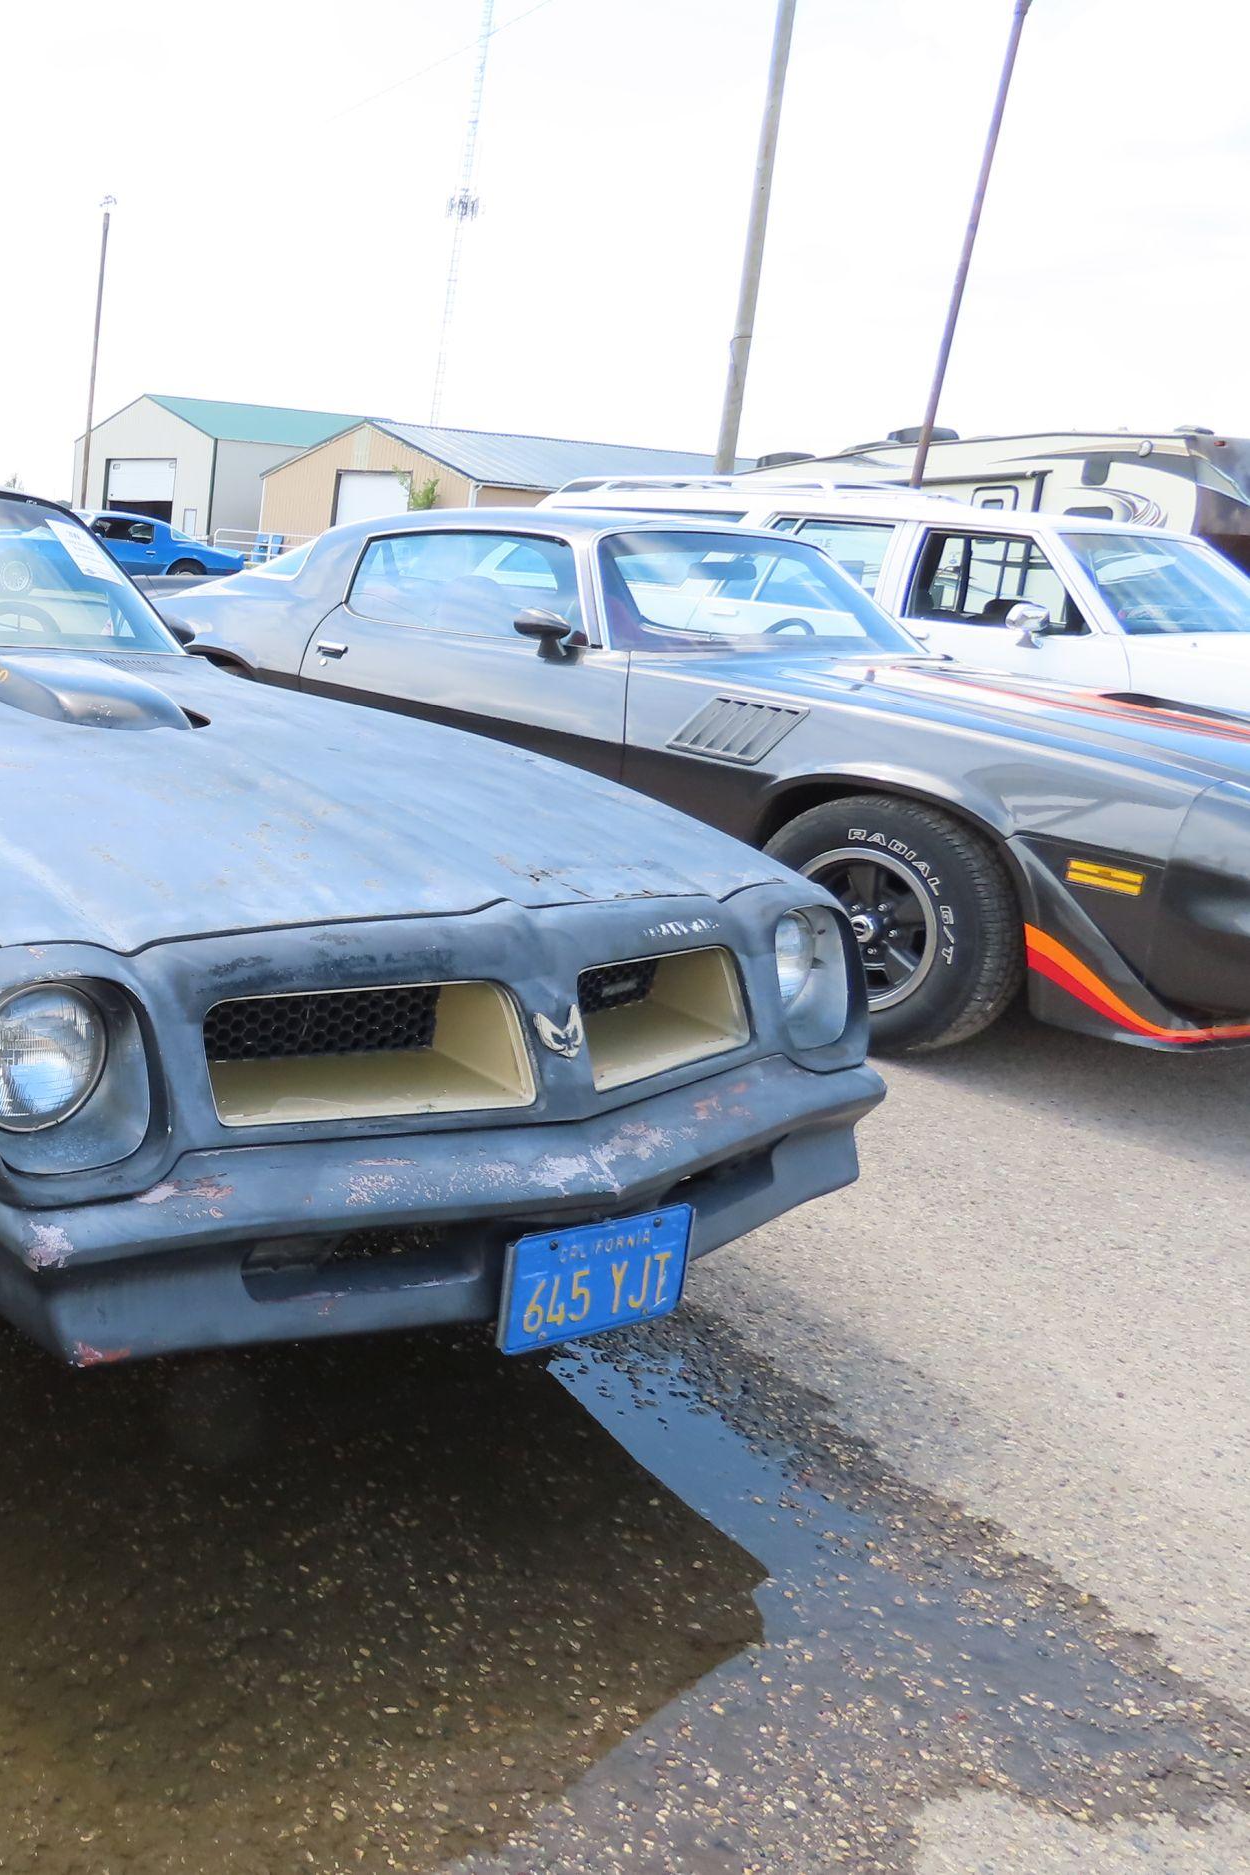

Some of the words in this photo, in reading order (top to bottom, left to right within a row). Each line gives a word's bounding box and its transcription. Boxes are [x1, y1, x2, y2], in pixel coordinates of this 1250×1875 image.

[848, 828, 941, 896] RADIAL
[559, 1229, 651, 1263] CALFORNIA
[522, 1268, 591, 1334] 645
[611, 1250, 673, 1315] YJT
